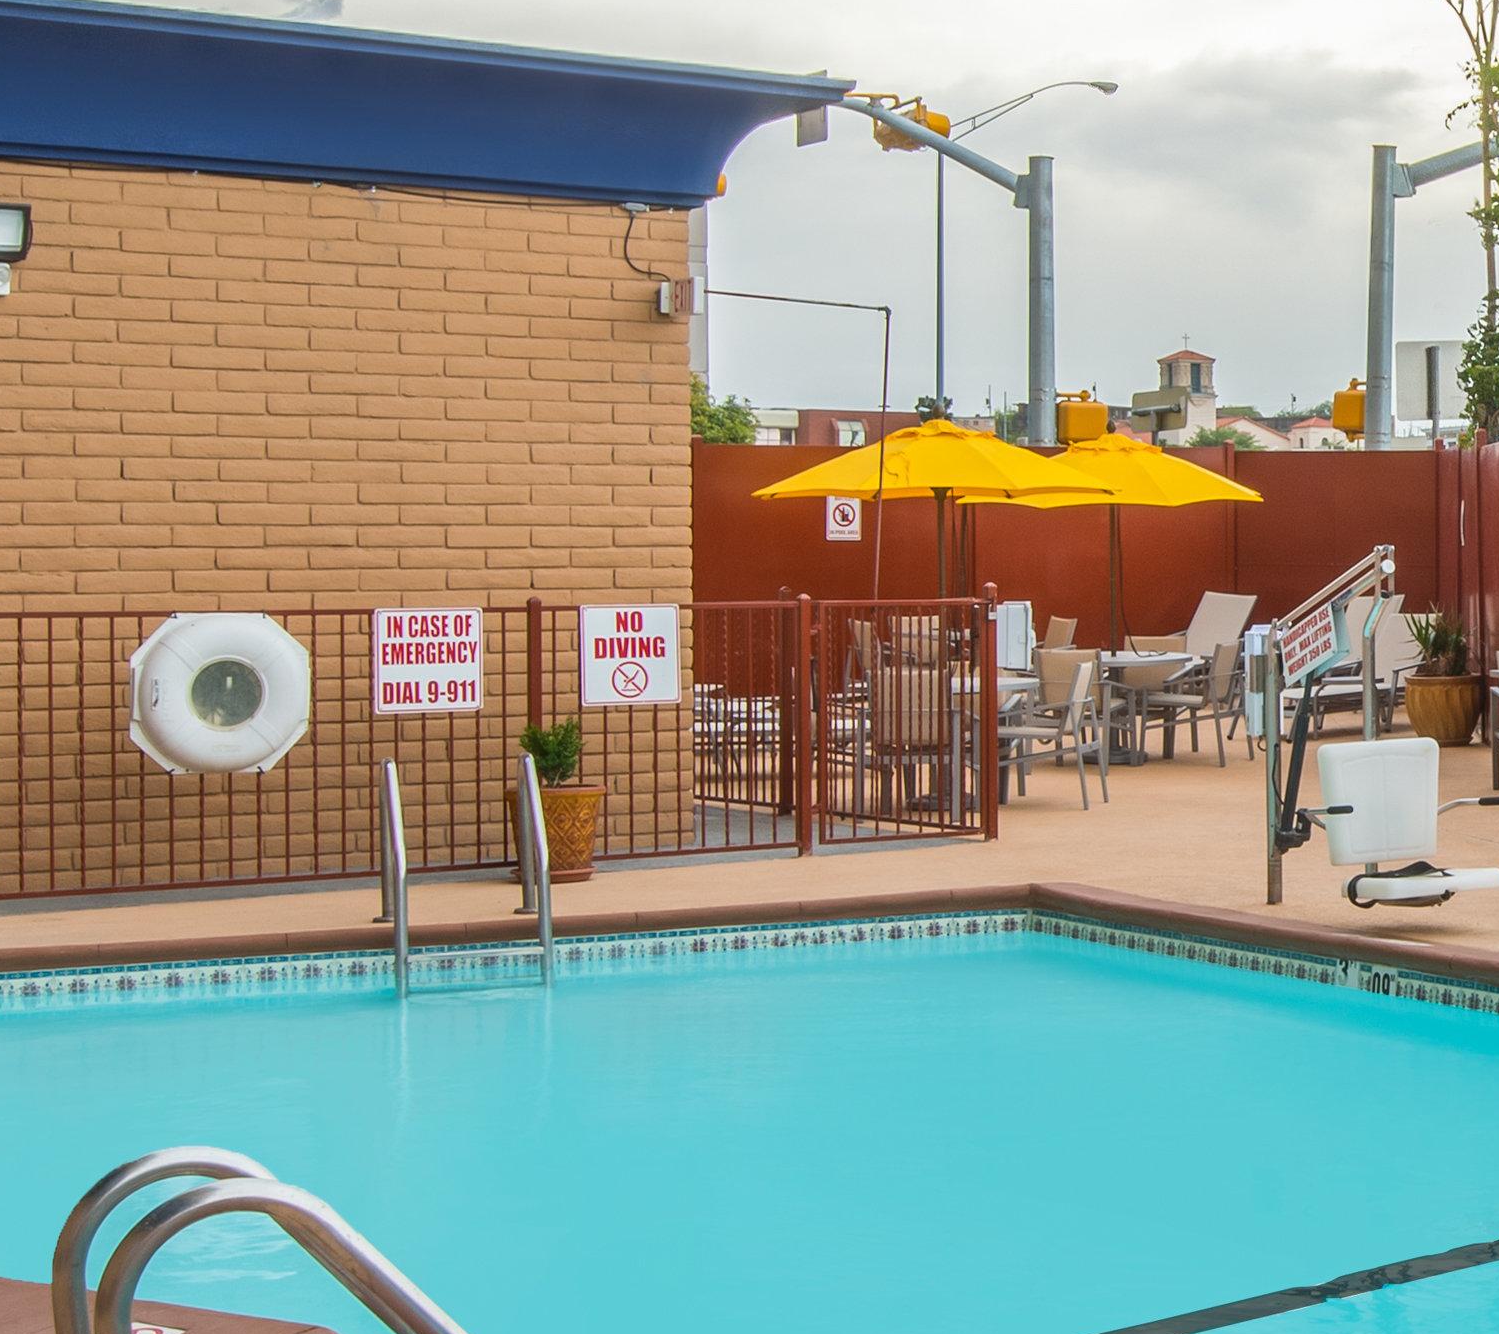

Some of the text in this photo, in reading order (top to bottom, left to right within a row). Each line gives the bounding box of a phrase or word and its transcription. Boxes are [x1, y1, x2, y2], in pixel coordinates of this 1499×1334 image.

[387, 615, 472, 638] IN CASE OF
[616, 611, 642, 633] NO
[1311, 621, 1332, 643] LIFTING
[382, 641, 477, 665] EMERGENCY
[594, 636, 665, 659] DIVING
[1288, 653, 1308, 676] WEIGHT
[382, 680, 476, 704] DIAL 9-911
